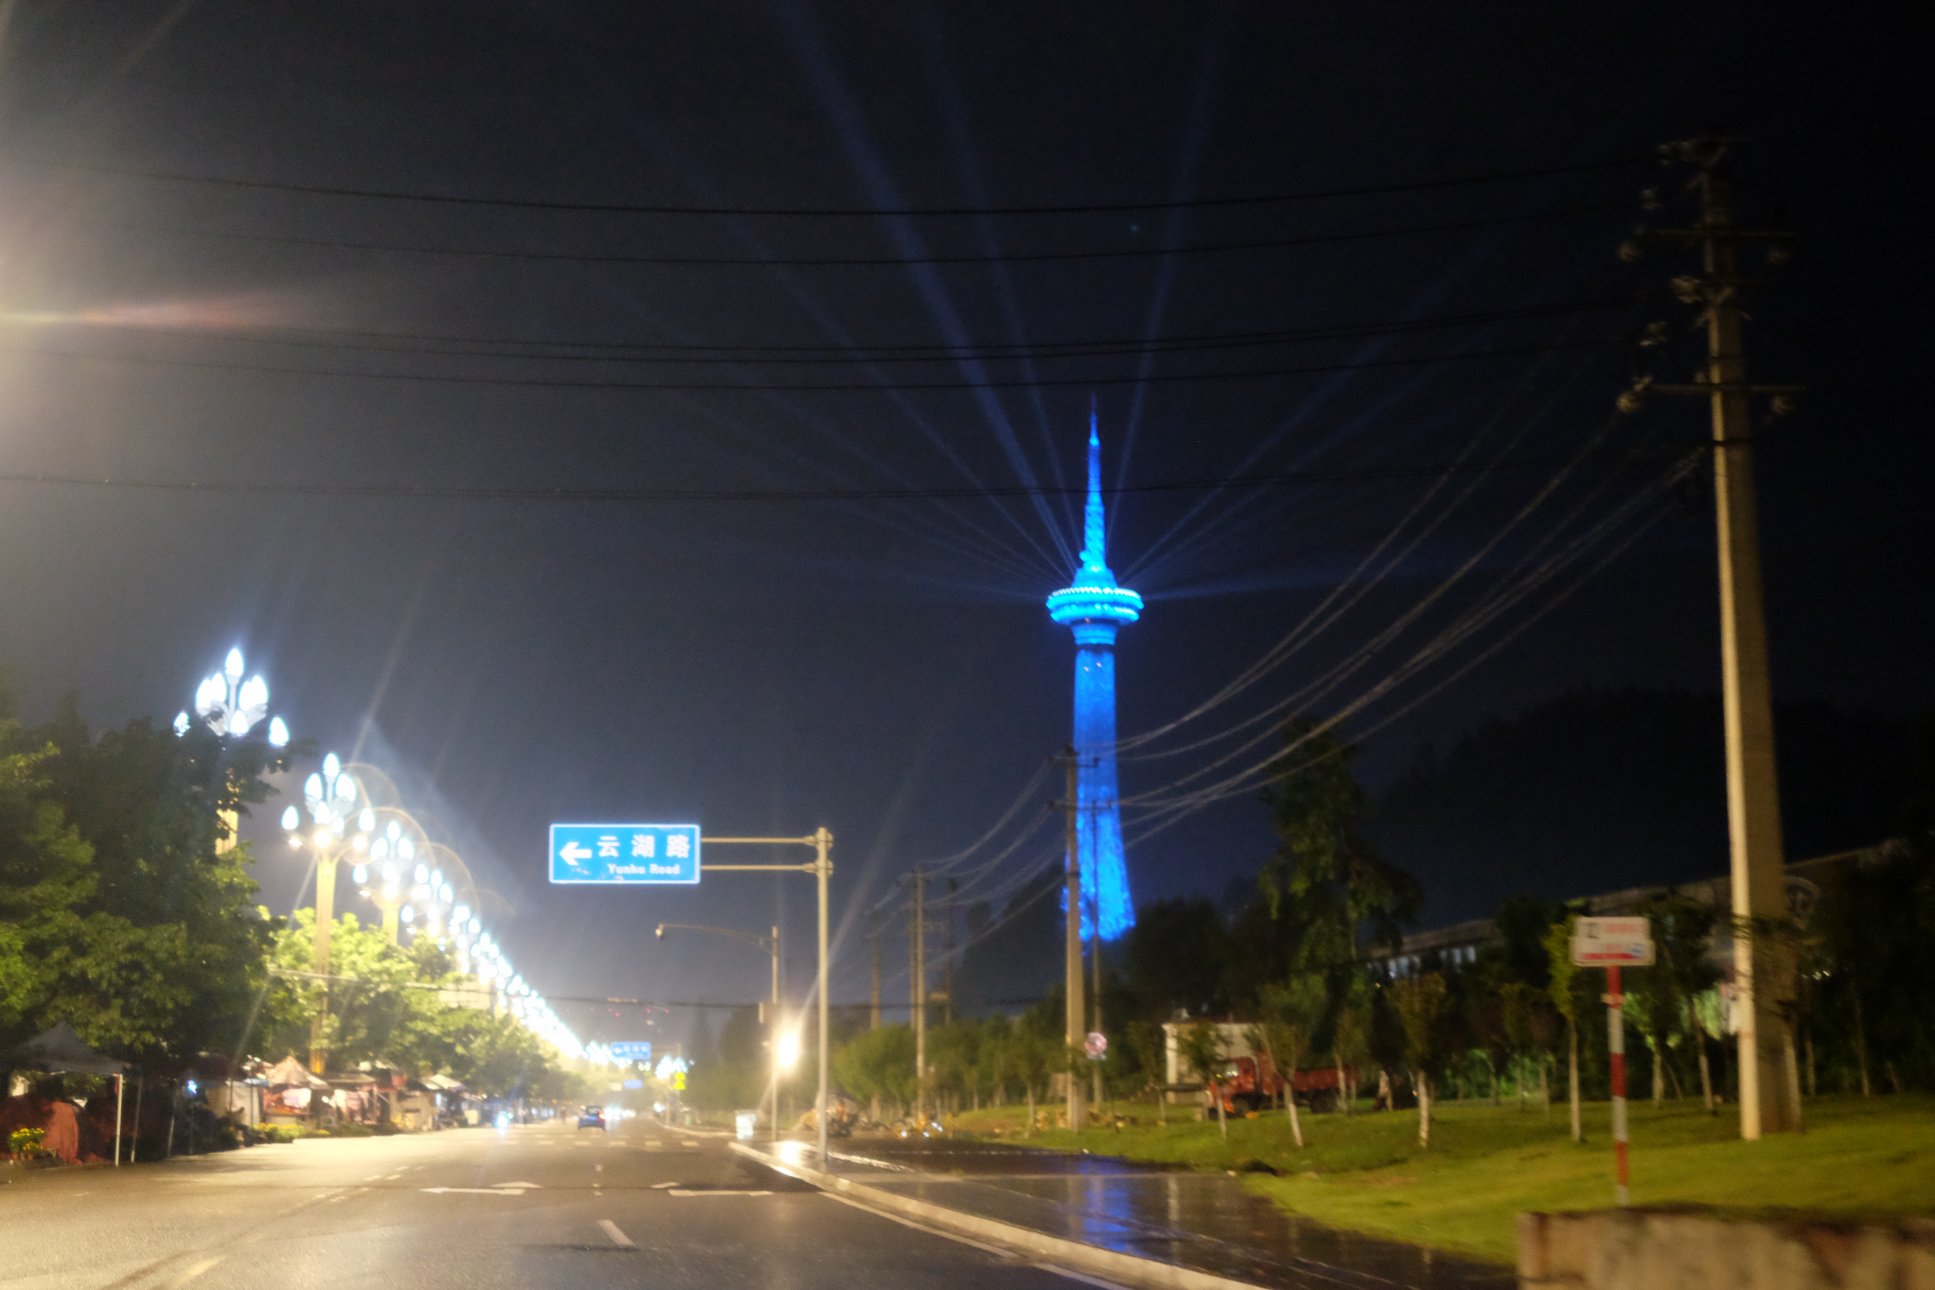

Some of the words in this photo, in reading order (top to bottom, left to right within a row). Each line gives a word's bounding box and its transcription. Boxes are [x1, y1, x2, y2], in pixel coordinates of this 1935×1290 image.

[597, 834, 690, 858] 云湖路
[649, 863, 681, 875] Road
